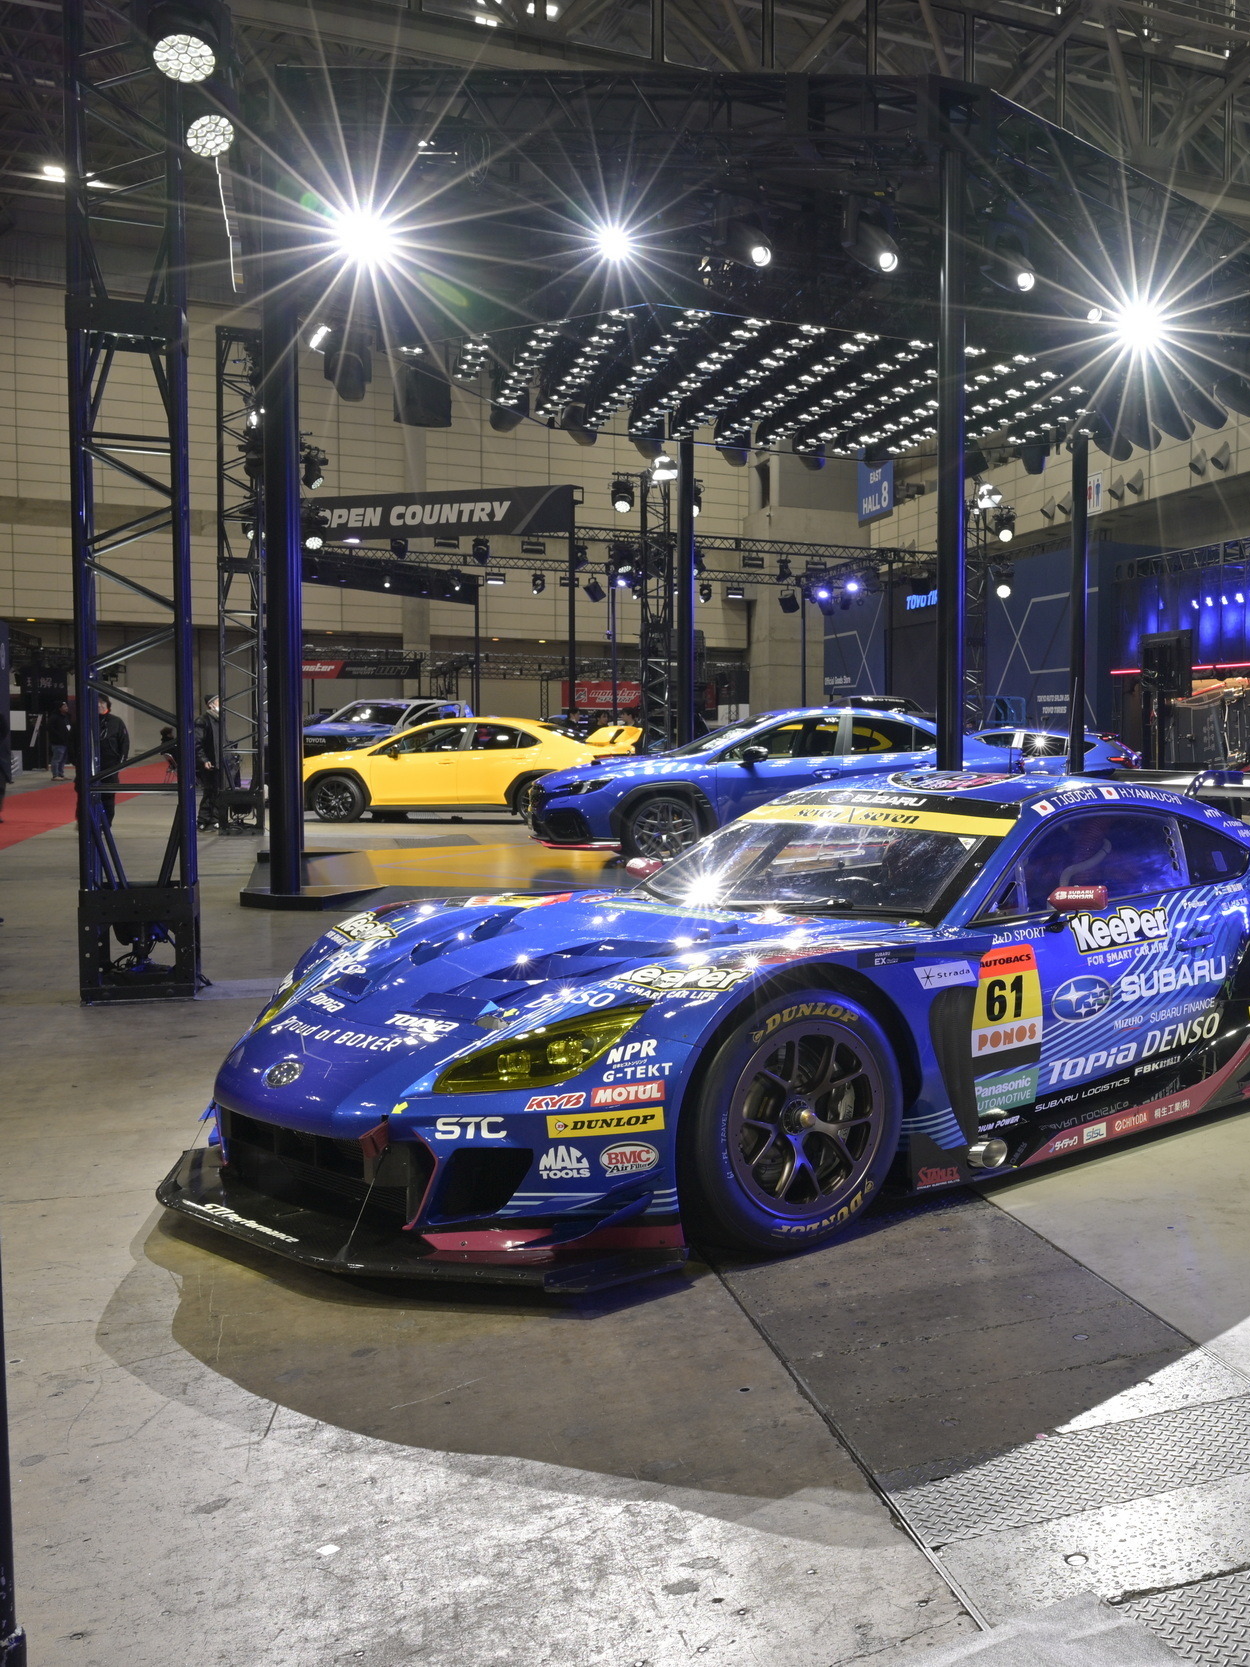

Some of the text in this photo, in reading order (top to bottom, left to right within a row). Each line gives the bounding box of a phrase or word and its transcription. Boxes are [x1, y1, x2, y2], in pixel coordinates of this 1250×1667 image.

[870, 469, 881, 484] EAST
[863, 481, 889, 515] HALL 8
[389, 501, 511, 526] COUNTRY
[906, 594, 927, 610] TOYO
[850, 793, 928, 807] SUBARU
[1050, 788, 1098, 807] T.IGUCHI
[1117, 787, 1183, 805] H.YAMAUCHI
[859, 810, 920, 825] seven
[992, 926, 1046, 944] R&D SPORT
[1071, 907, 1168, 951] KeePer
[874, 958, 886, 966] EX
[979, 953, 1032, 968] AUTOBACS
[1087, 941, 1169, 966] FOR SMART CAR LIFE
[937, 968, 971, 979] Strada
[1121, 955, 1227, 1002] SUBARU
[600, 981, 719, 1000] FOR SMART CAR LIFE
[986, 974, 1024, 1022] 61
[765, 1002, 860, 1035] DUNLOP
[1113, 997, 1215, 1030] MIZUHO SUBARU FINANCE
[283, 1016, 403, 1052] Proud of BOXER
[977, 1022, 1037, 1051] PONOS
[1142, 1012, 1220, 1058] DENSO
[606, 1039, 658, 1064] NPR
[602, 1062, 673, 1083] G-TEKT
[1134, 1061, 1160, 1077] FBK
[594, 1082, 662, 1104] MOTUL
[975, 1075, 1032, 1097] Panasonic
[1034, 1077, 1131, 1113] SUBARU LOGISTICS
[524, 1092, 587, 1112] KYB
[977, 1089, 1032, 1112] UTOMOTIVE
[435, 1116, 508, 1140] STC
[570, 1114, 655, 1131] DUNLOP
[994, 1114, 1021, 1128] POWER
[1121, 1112, 1148, 1130] CHIYODA
[1054, 1135, 1078, 1151] ダイテック
[539, 1145, 590, 1170] MAC
[607, 1149, 651, 1166] BMC
[610, 1162, 649, 1173] Air Filter
[539, 1168, 591, 1179] TOOLS
[917, 1166, 960, 1186] STANLEY
